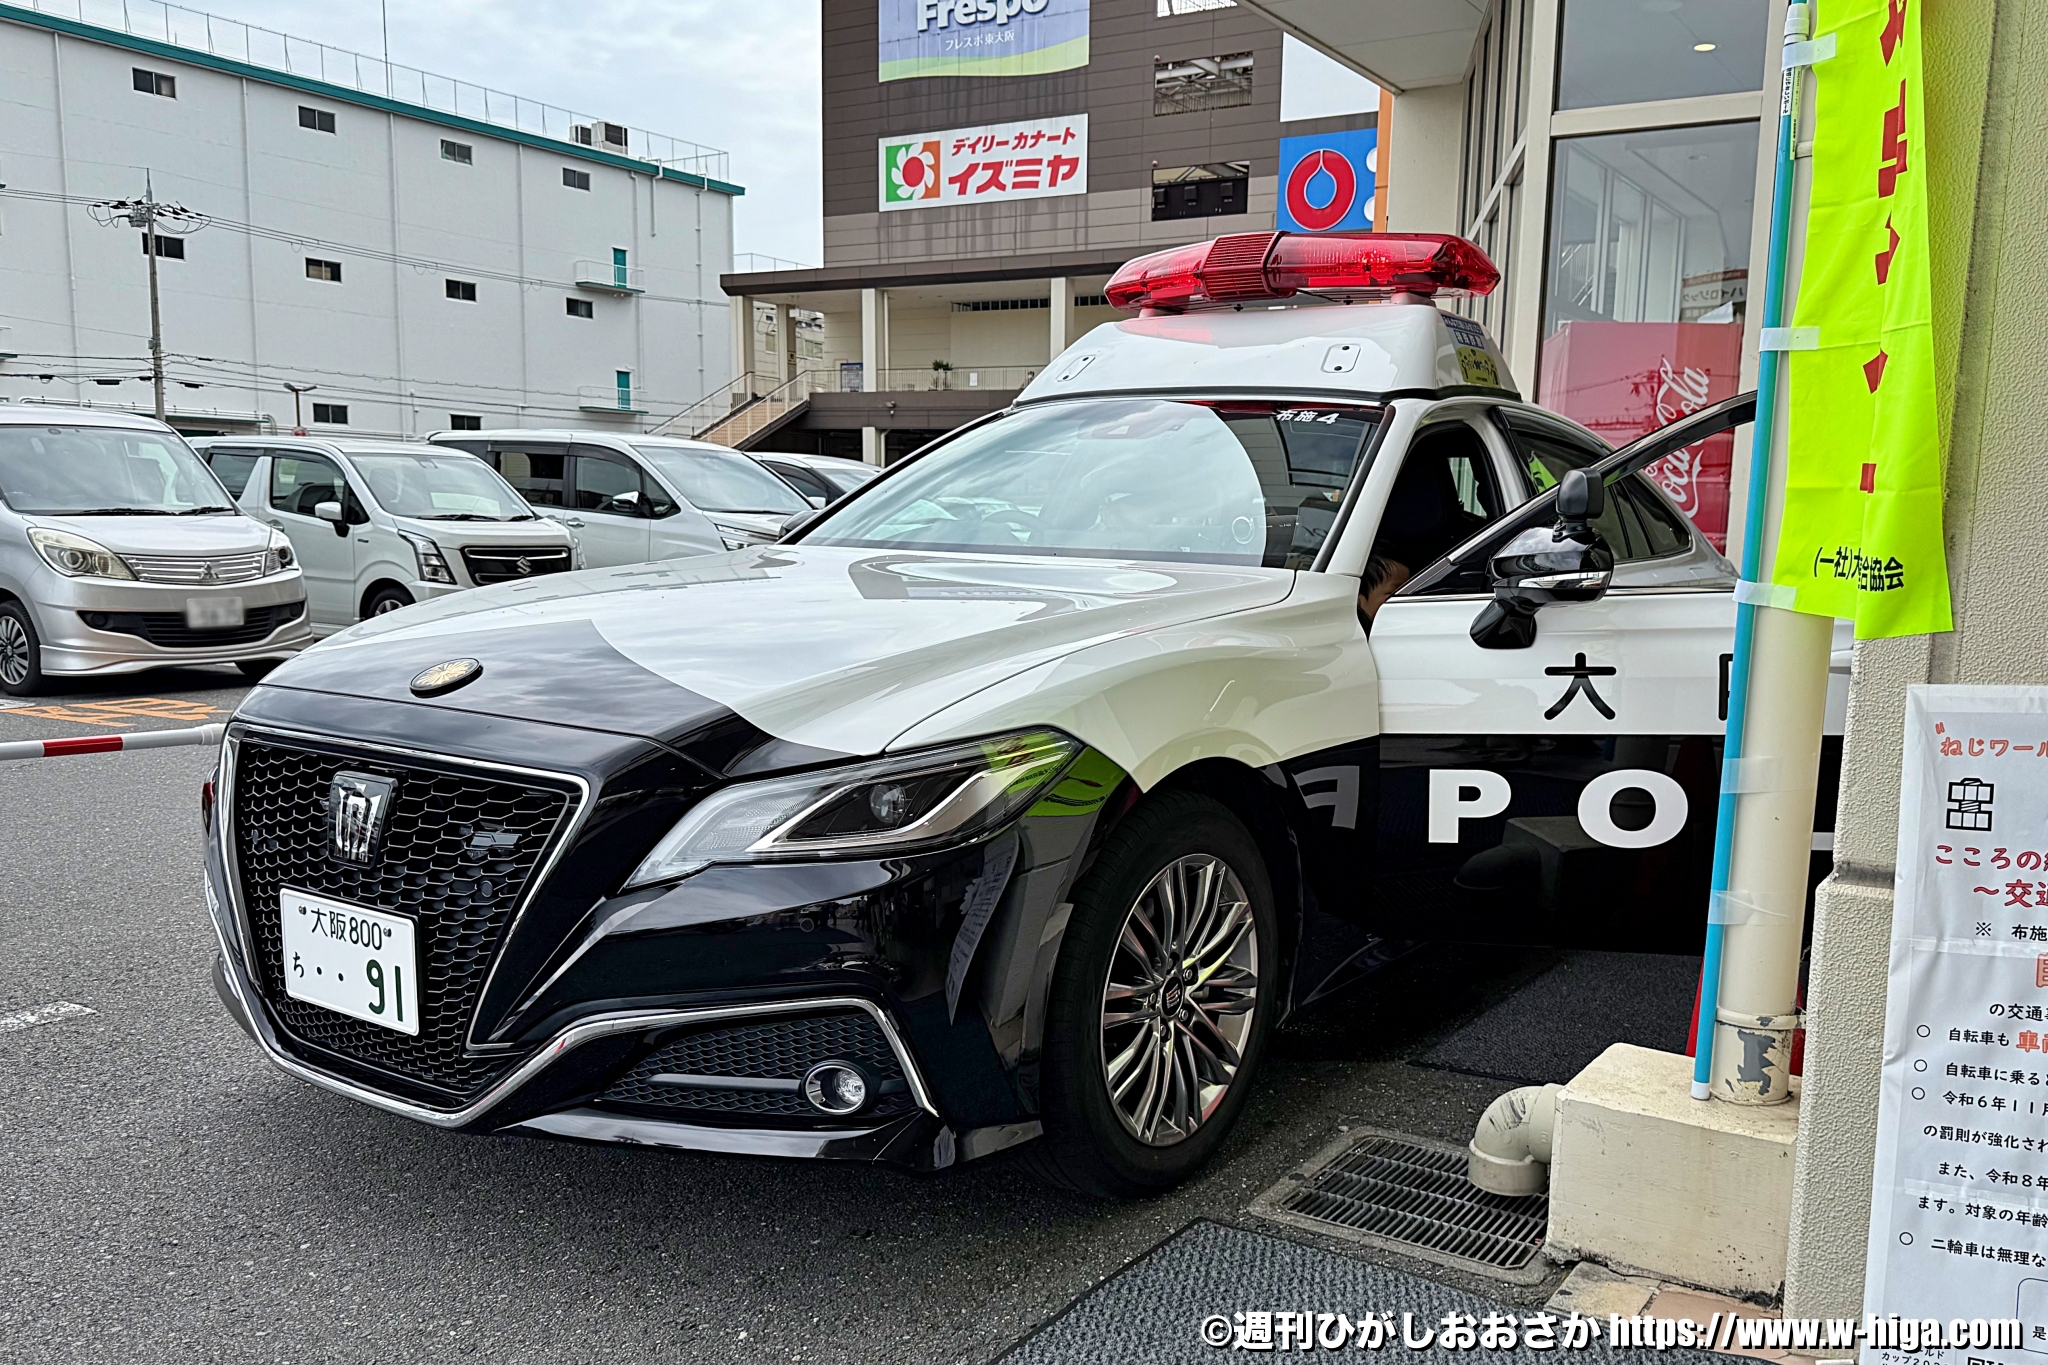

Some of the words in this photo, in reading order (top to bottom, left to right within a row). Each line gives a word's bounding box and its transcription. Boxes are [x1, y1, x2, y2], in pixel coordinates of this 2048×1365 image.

[945, 30, 1015, 51] フレスポ東大阪
[948, 155, 1079, 197] イズミヤ
[1276, 409, 1340, 425] 布施4
[1936, 845, 2048, 871] こころの
[1989, 1003, 2048, 1021] の交通
[2016, 1030, 2048, 1053] 車
[1946, 1062, 2048, 1086] 自転車に乗る
[1931, 1238, 2047, 1268] 二輪車は無理な
